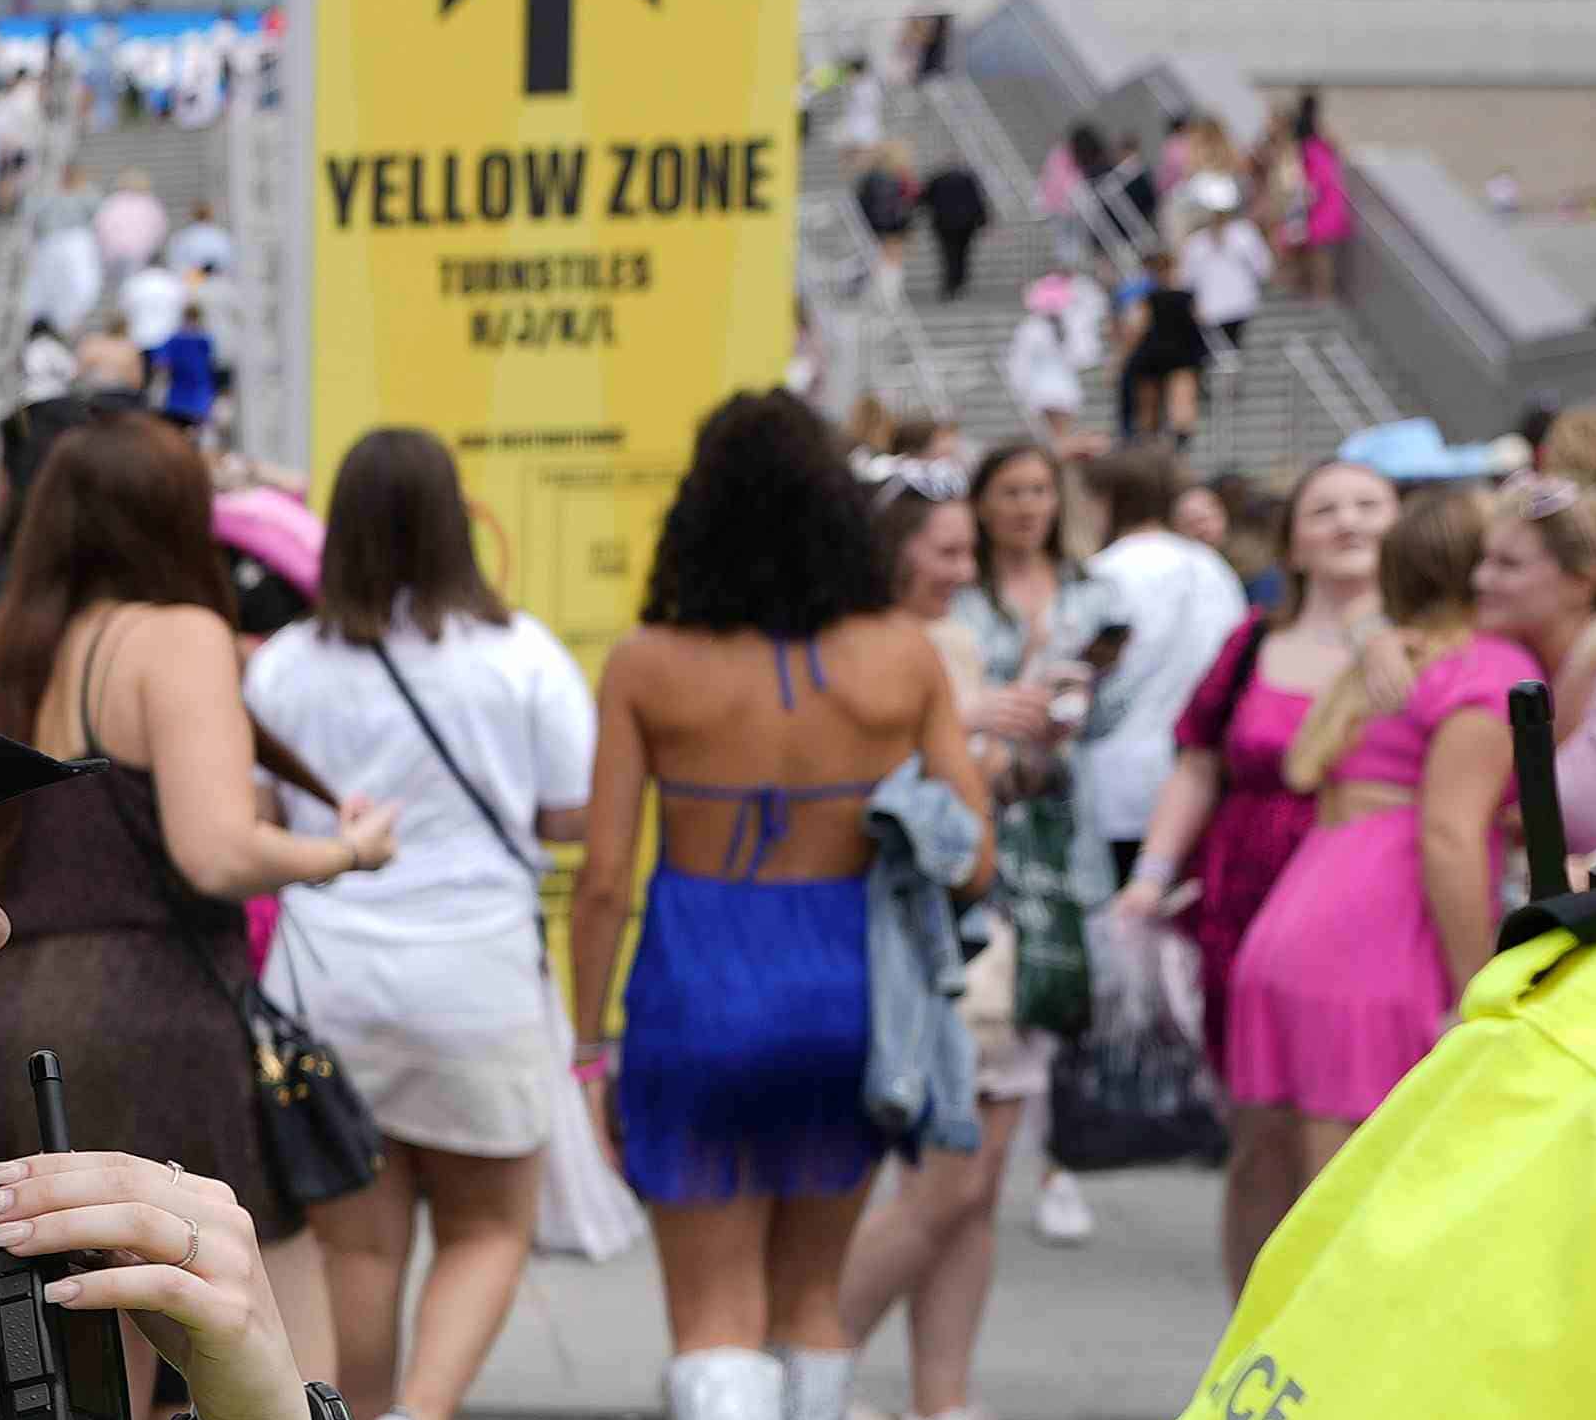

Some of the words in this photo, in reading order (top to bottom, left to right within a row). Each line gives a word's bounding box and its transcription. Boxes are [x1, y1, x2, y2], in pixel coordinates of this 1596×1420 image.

[325, 148, 588, 229] YELLOW
[606, 137, 774, 215] ZONE
[436, 251, 652, 297] TURNSTILES
